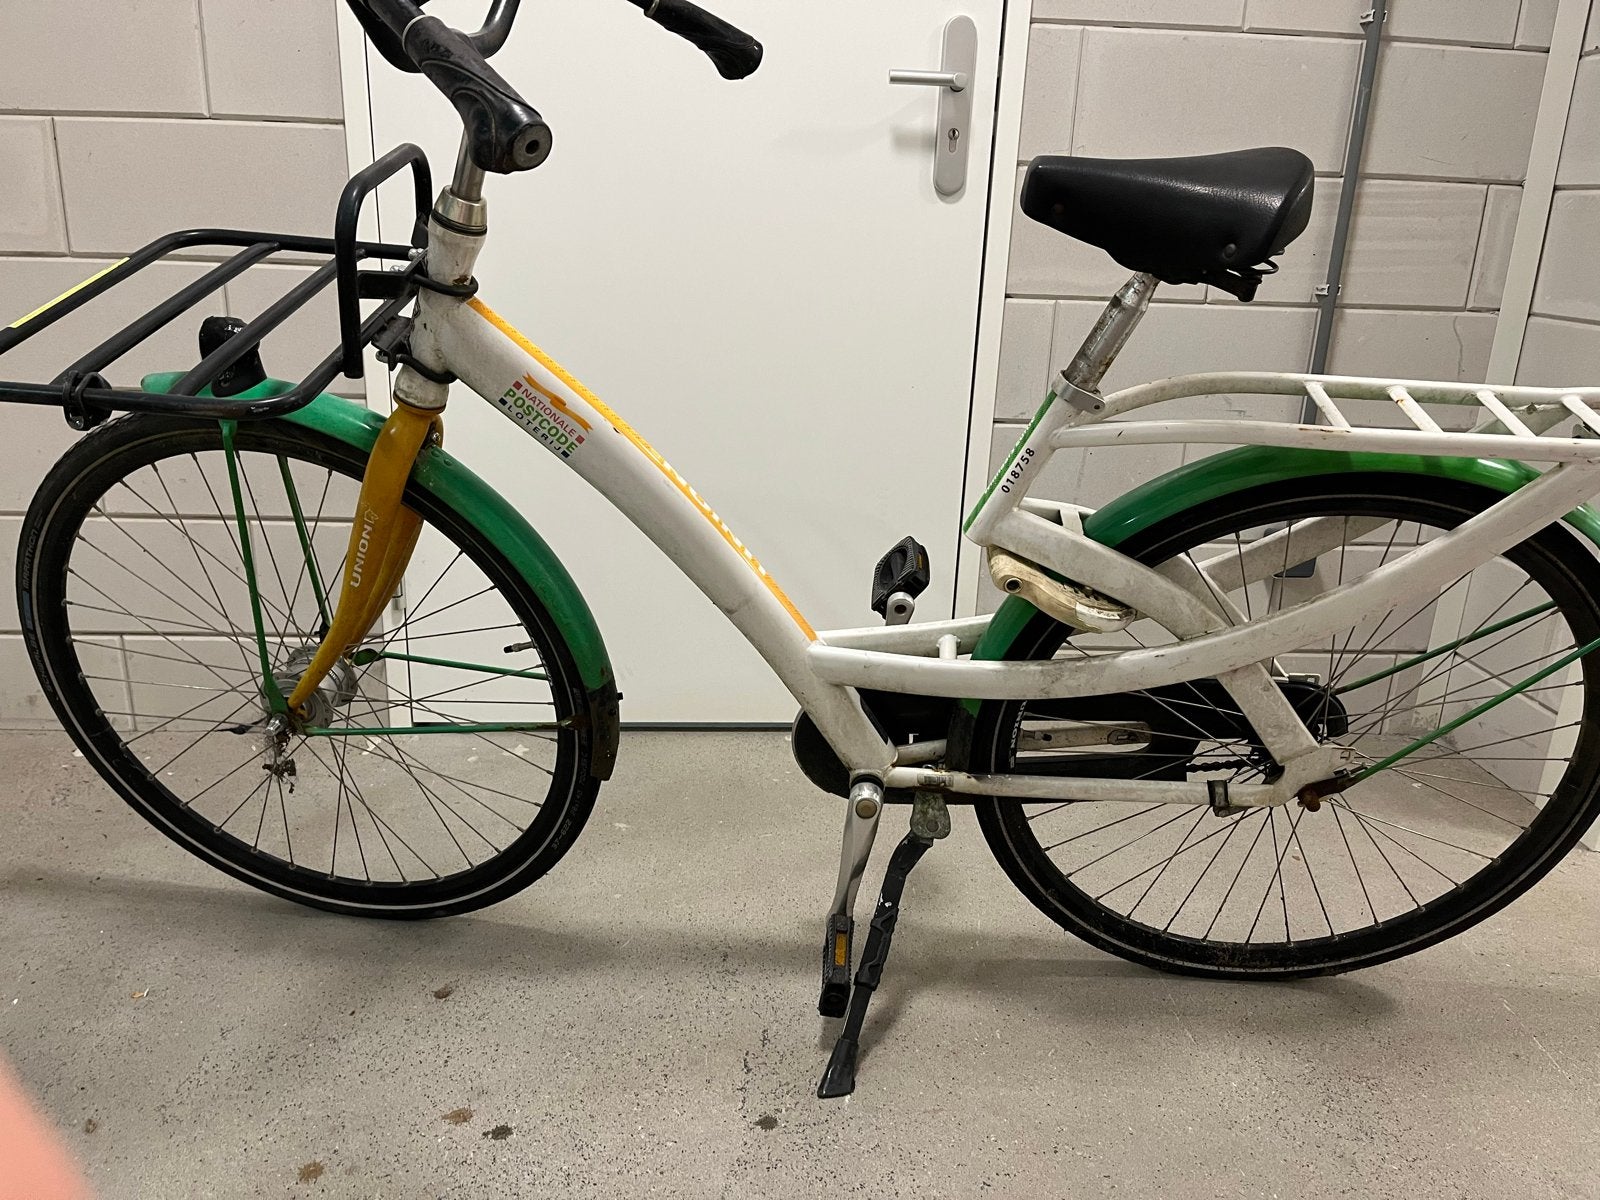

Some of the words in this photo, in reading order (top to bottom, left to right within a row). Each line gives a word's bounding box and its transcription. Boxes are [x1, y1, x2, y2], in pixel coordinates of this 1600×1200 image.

[503, 388, 578, 454] POSTCODE
[507, 405, 562, 451] LOTERIJ
[521, 388, 577, 437] NATIONALE
[1001, 447, 1035, 493] 018758
[350, 523, 373, 588] UNION
